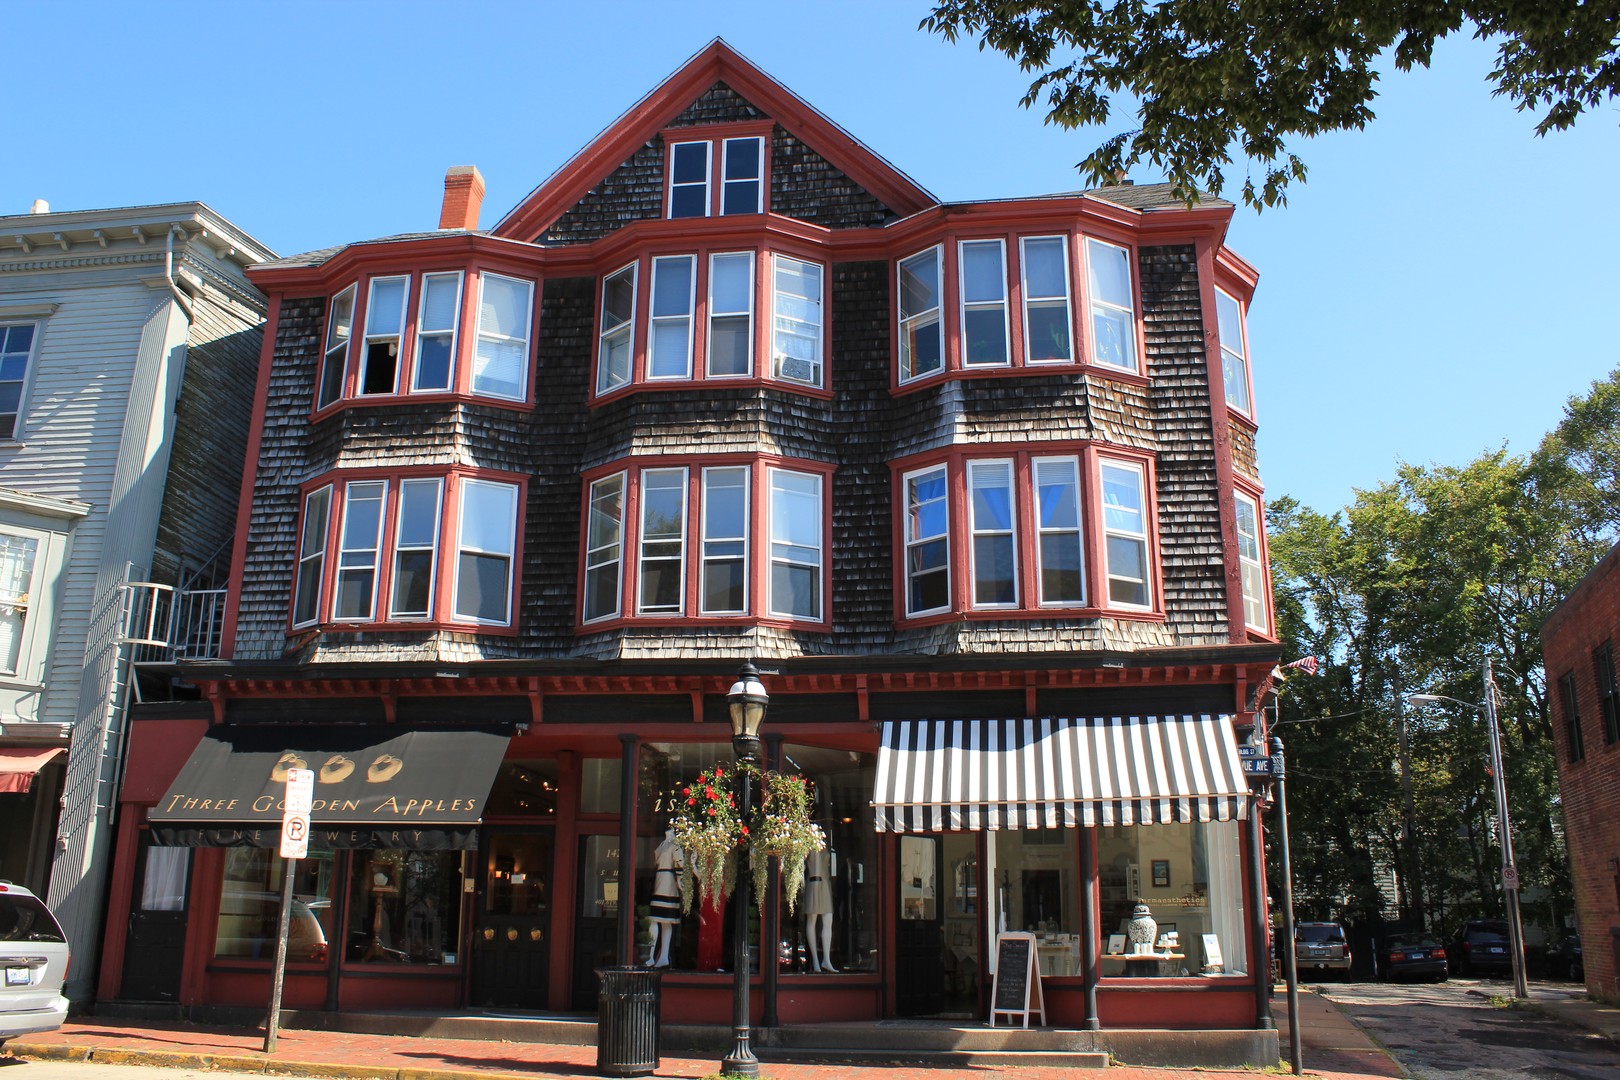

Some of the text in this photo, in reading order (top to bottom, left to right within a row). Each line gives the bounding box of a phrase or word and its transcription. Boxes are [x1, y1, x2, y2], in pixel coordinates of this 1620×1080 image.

[1256, 760, 1268, 771] AVE
[166, 794, 239, 813] THREE
[373, 795, 476, 813] APPLES
[198, 829, 262, 841] FINE
